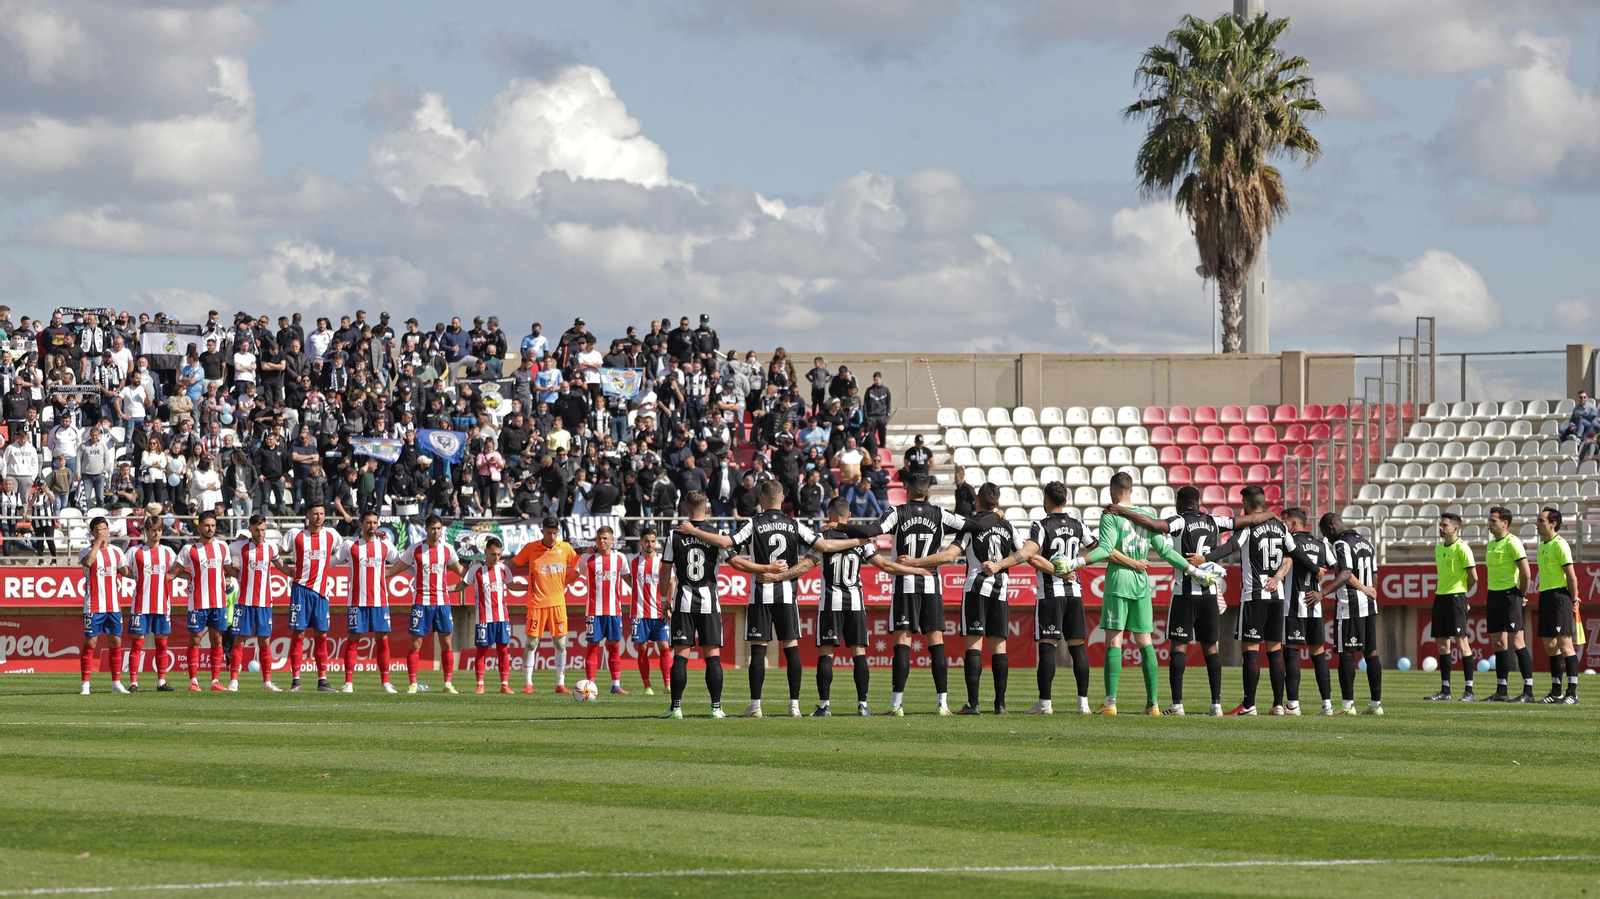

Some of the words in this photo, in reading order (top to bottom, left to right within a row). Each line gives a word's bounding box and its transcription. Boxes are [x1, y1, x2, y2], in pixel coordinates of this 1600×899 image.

[758, 522, 788, 534] CONNOR
[1122, 520, 1148, 554] 24
[768, 534, 786, 564] 2
[904, 534, 934, 558] 17
[1302, 544, 1320, 553] LOREN
[1258, 538, 1283, 570] 15
[687, 548, 706, 582] 8
[830, 552, 860, 587] 10
[1358, 556, 1374, 586] 11
[84, 618, 92, 629] 12
[132, 616, 140, 627] 14
[190, 613, 196, 624] 4
[349, 614, 358, 626] 21
[412, 617, 418, 628] 9
[529, 618, 538, 630] 13
[478, 628, 486, 640] 10
